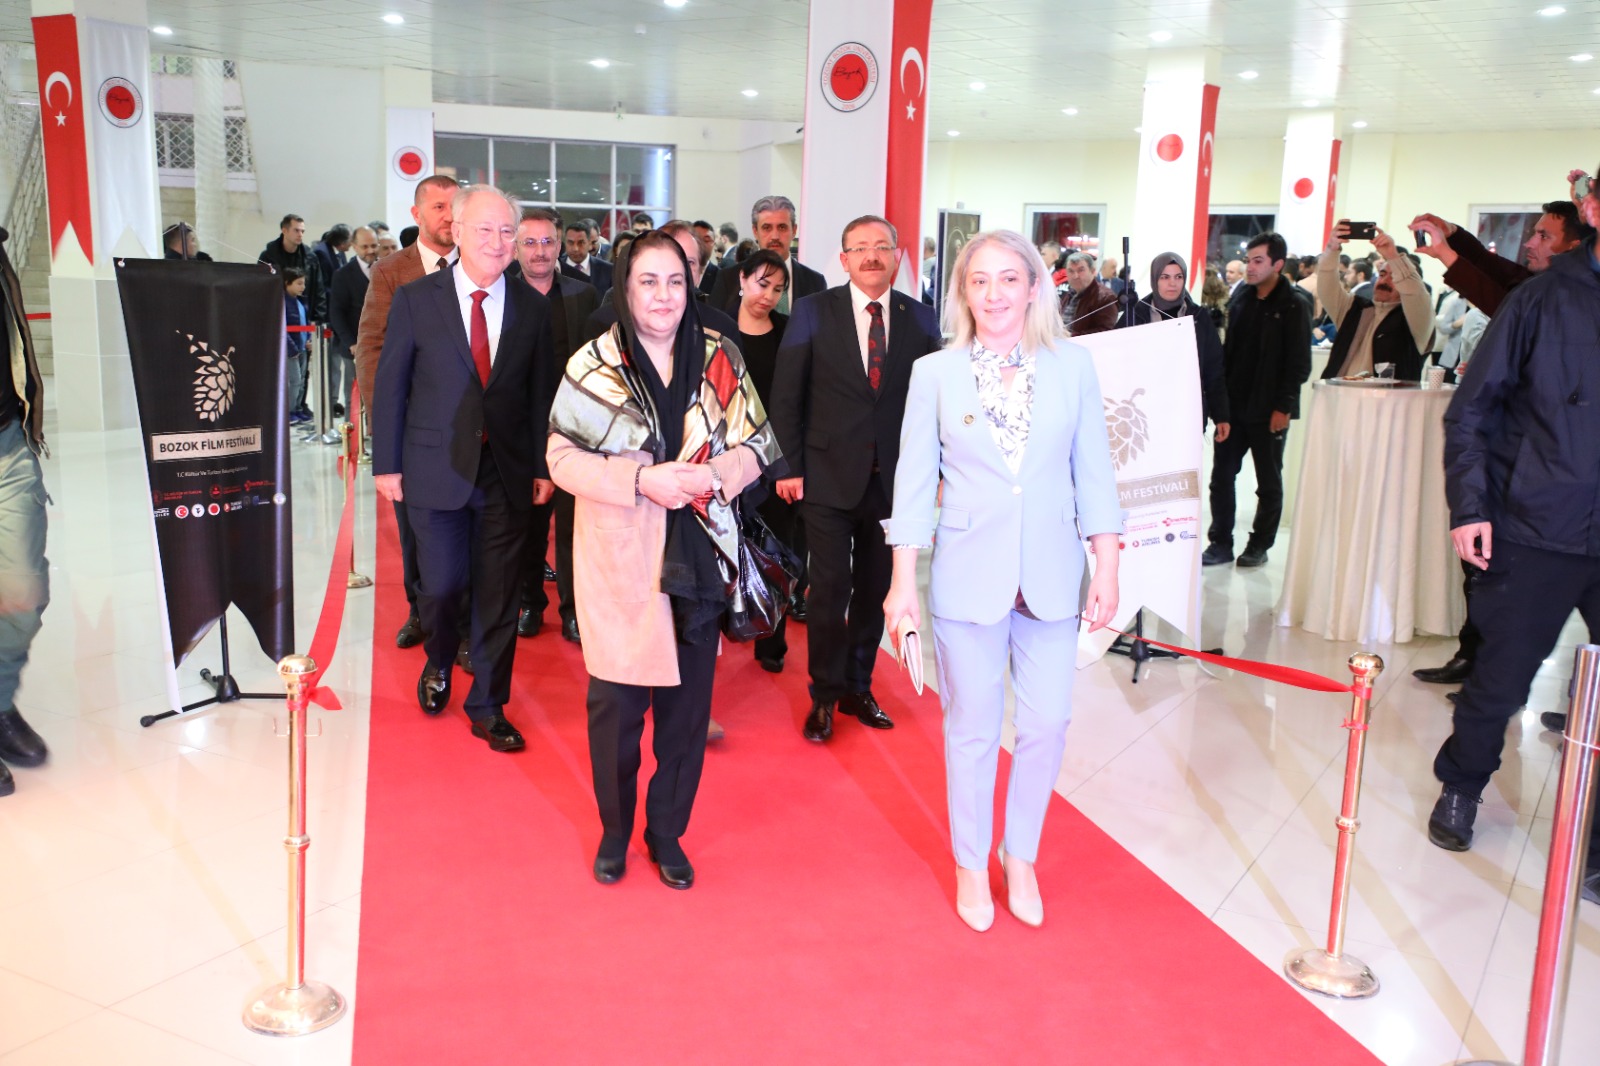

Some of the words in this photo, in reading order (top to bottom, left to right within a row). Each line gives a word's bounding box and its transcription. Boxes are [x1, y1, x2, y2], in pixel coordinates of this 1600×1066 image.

[160, 441, 199, 453] BOZOK
[201, 438, 225, 450] FİLM
[225, 434, 256, 449] FESTİVALİ
[1133, 478, 1189, 499] FESTİVALİ
